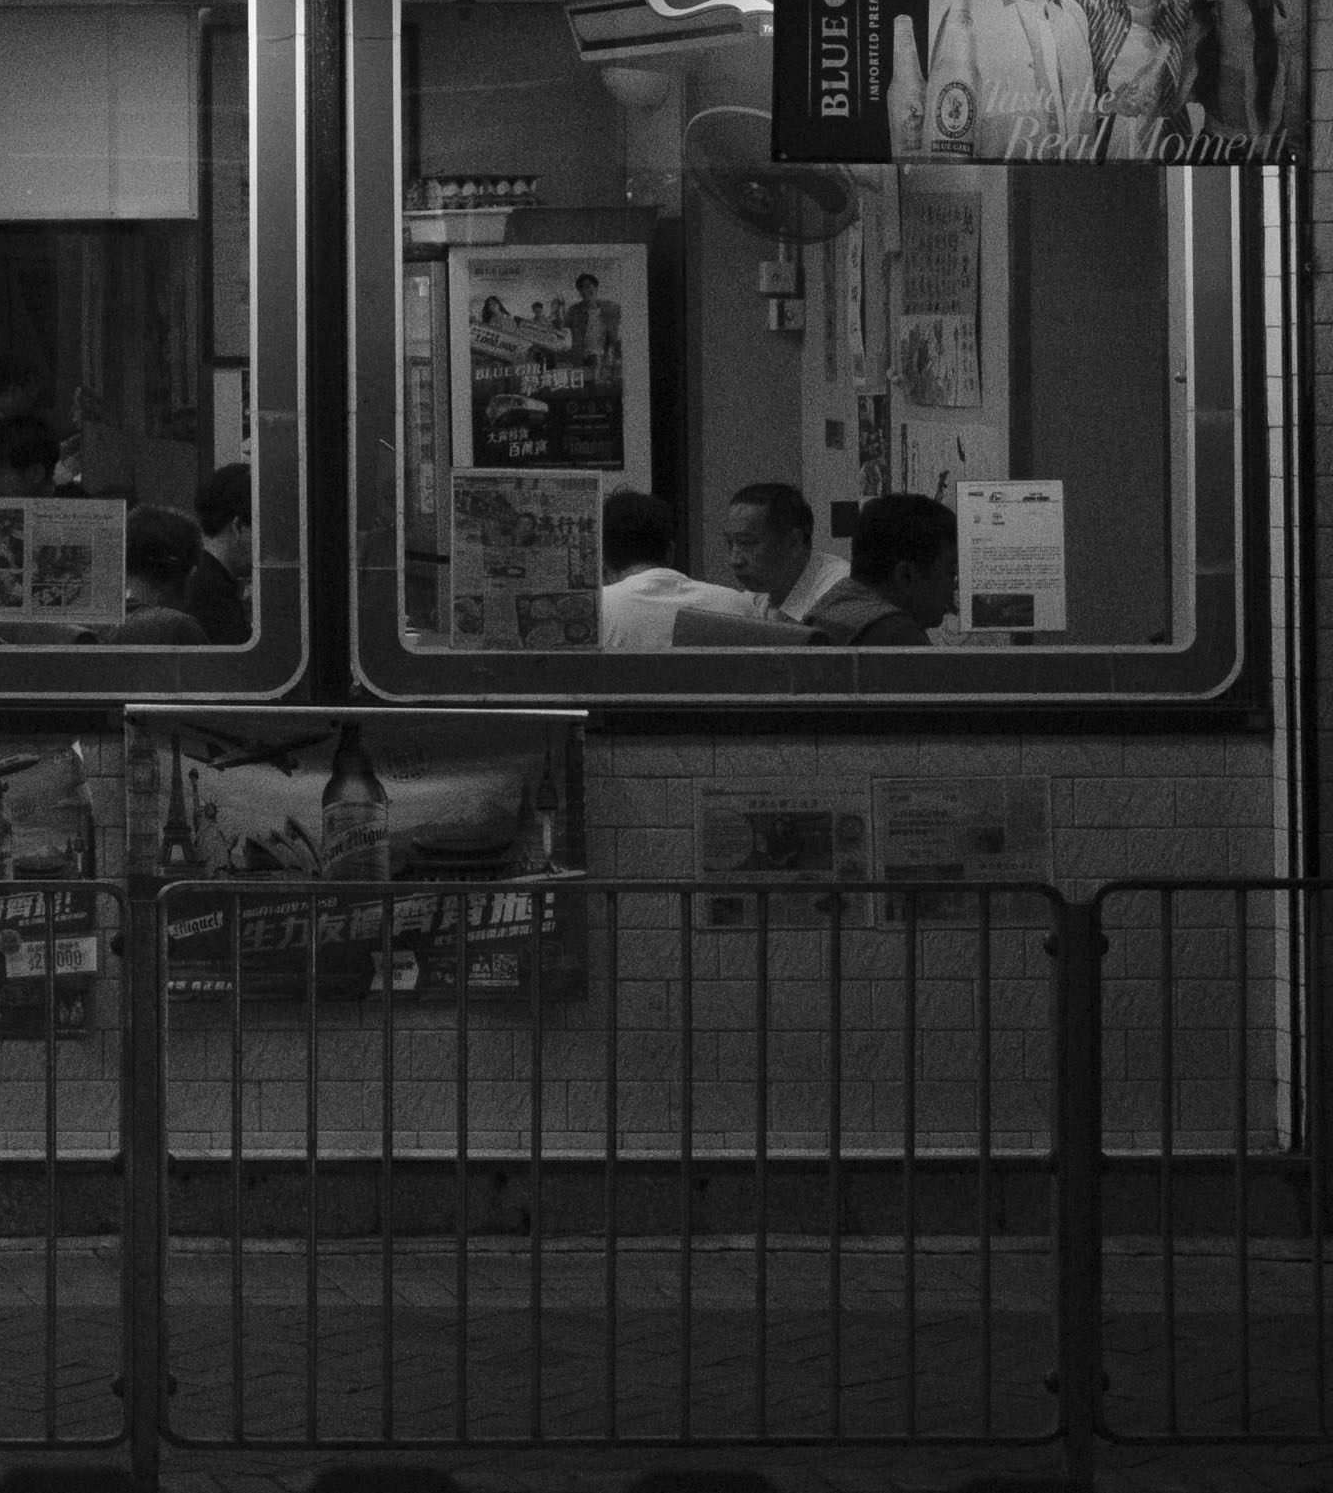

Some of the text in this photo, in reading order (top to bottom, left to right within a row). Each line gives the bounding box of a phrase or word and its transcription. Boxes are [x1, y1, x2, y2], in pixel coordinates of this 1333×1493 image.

[820, 16, 850, 118] BLUE
[868, 33, 880, 102] IMPORTED
[981, 78, 1056, 114] Taste
[1077, 80, 1116, 113] the
[1003, 116, 1104, 161] Real
